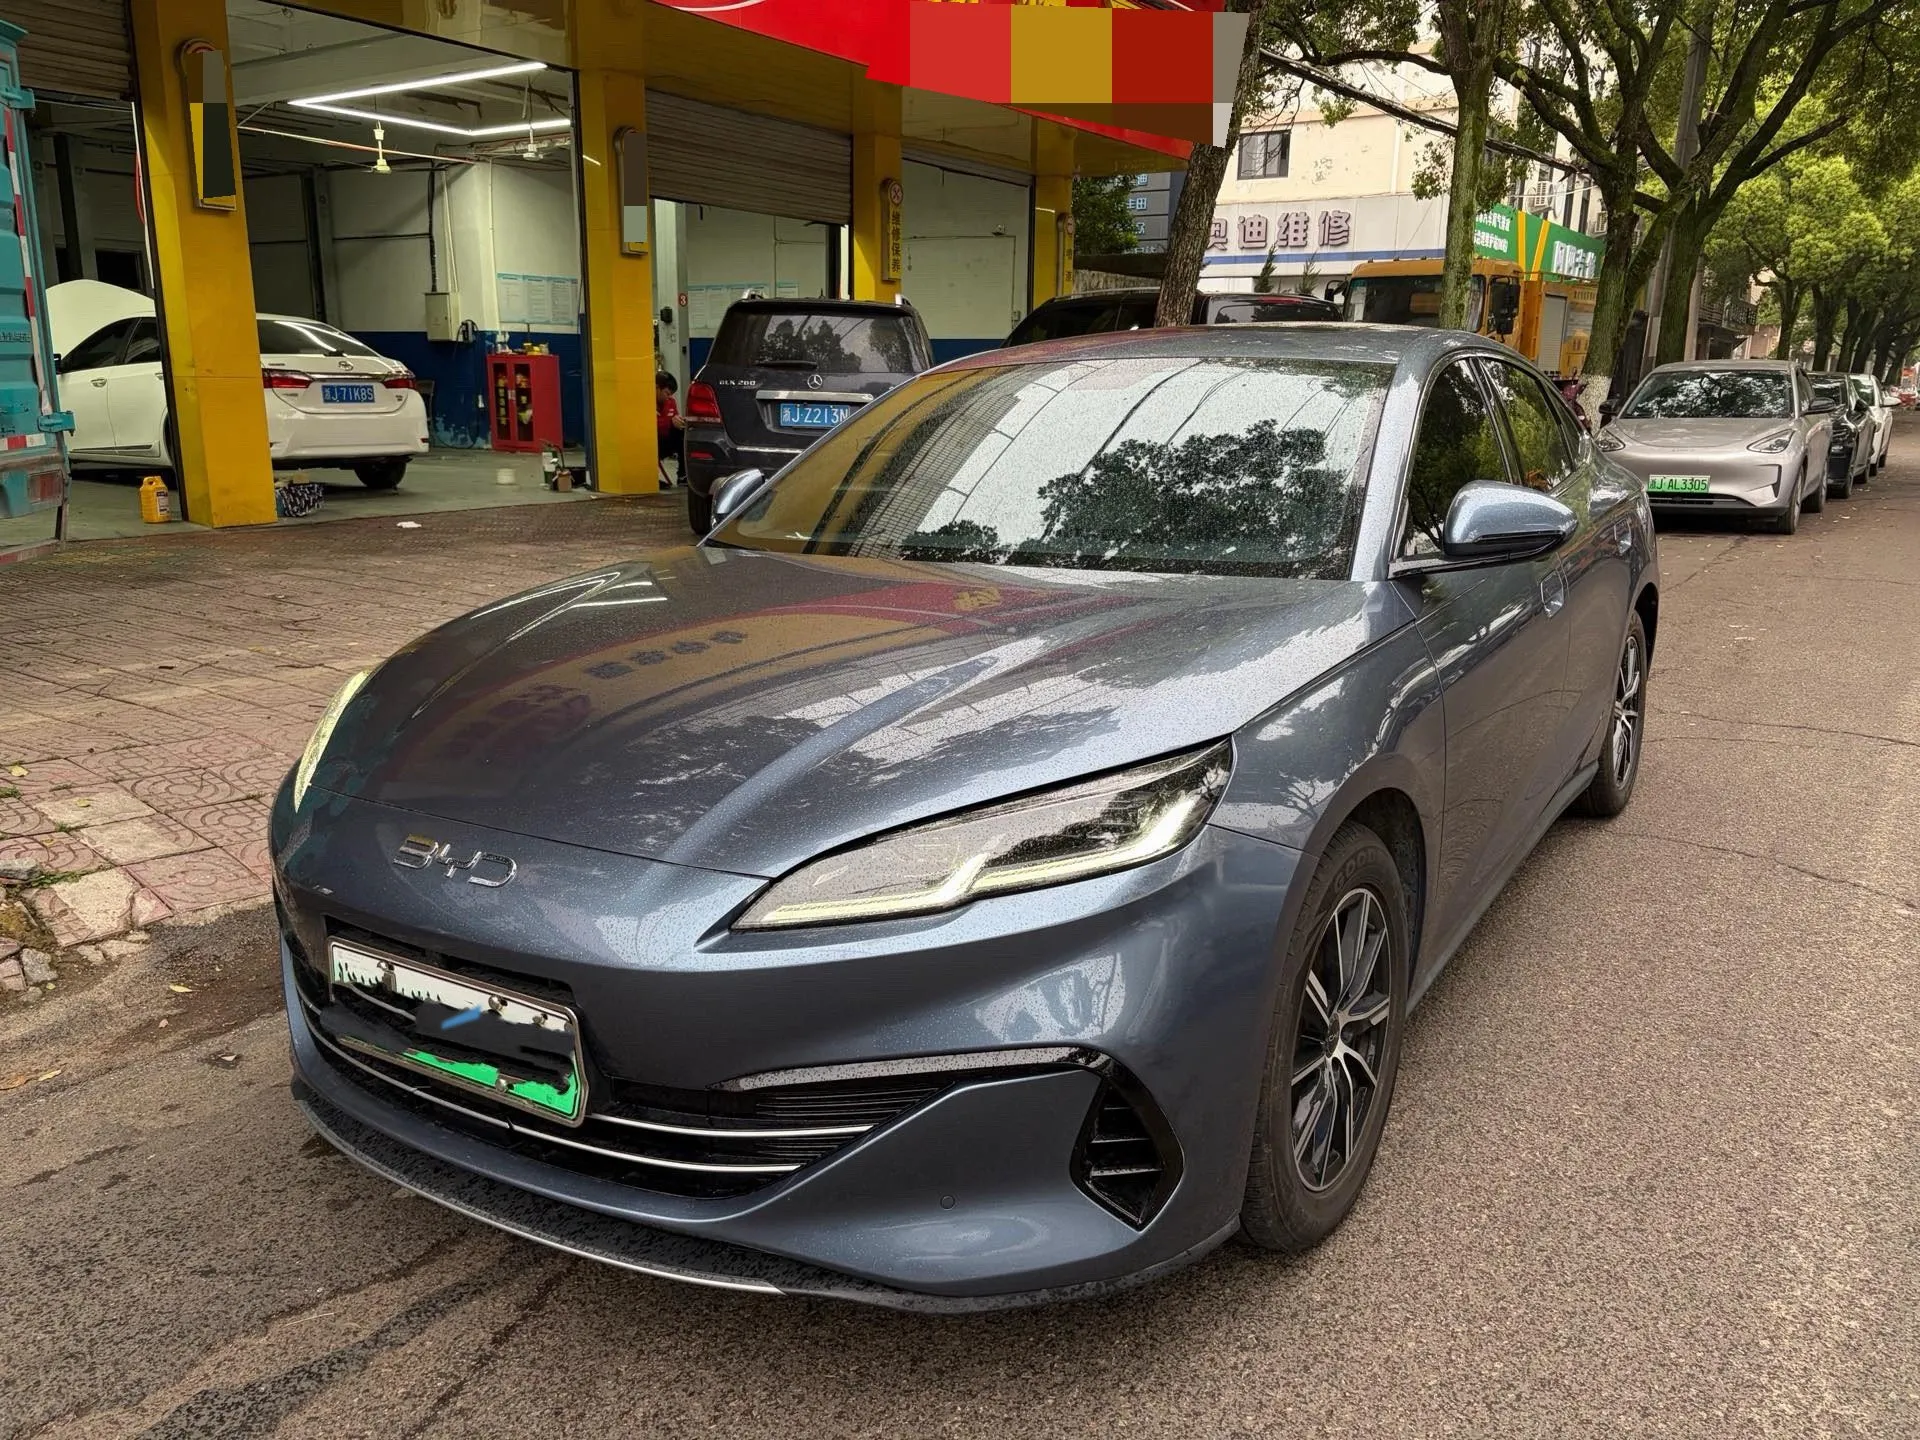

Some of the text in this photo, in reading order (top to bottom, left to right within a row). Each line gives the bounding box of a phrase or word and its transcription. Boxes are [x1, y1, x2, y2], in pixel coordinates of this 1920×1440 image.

[891, 211, 901, 273] 维修保养
[392, 834, 518, 888] BYD
